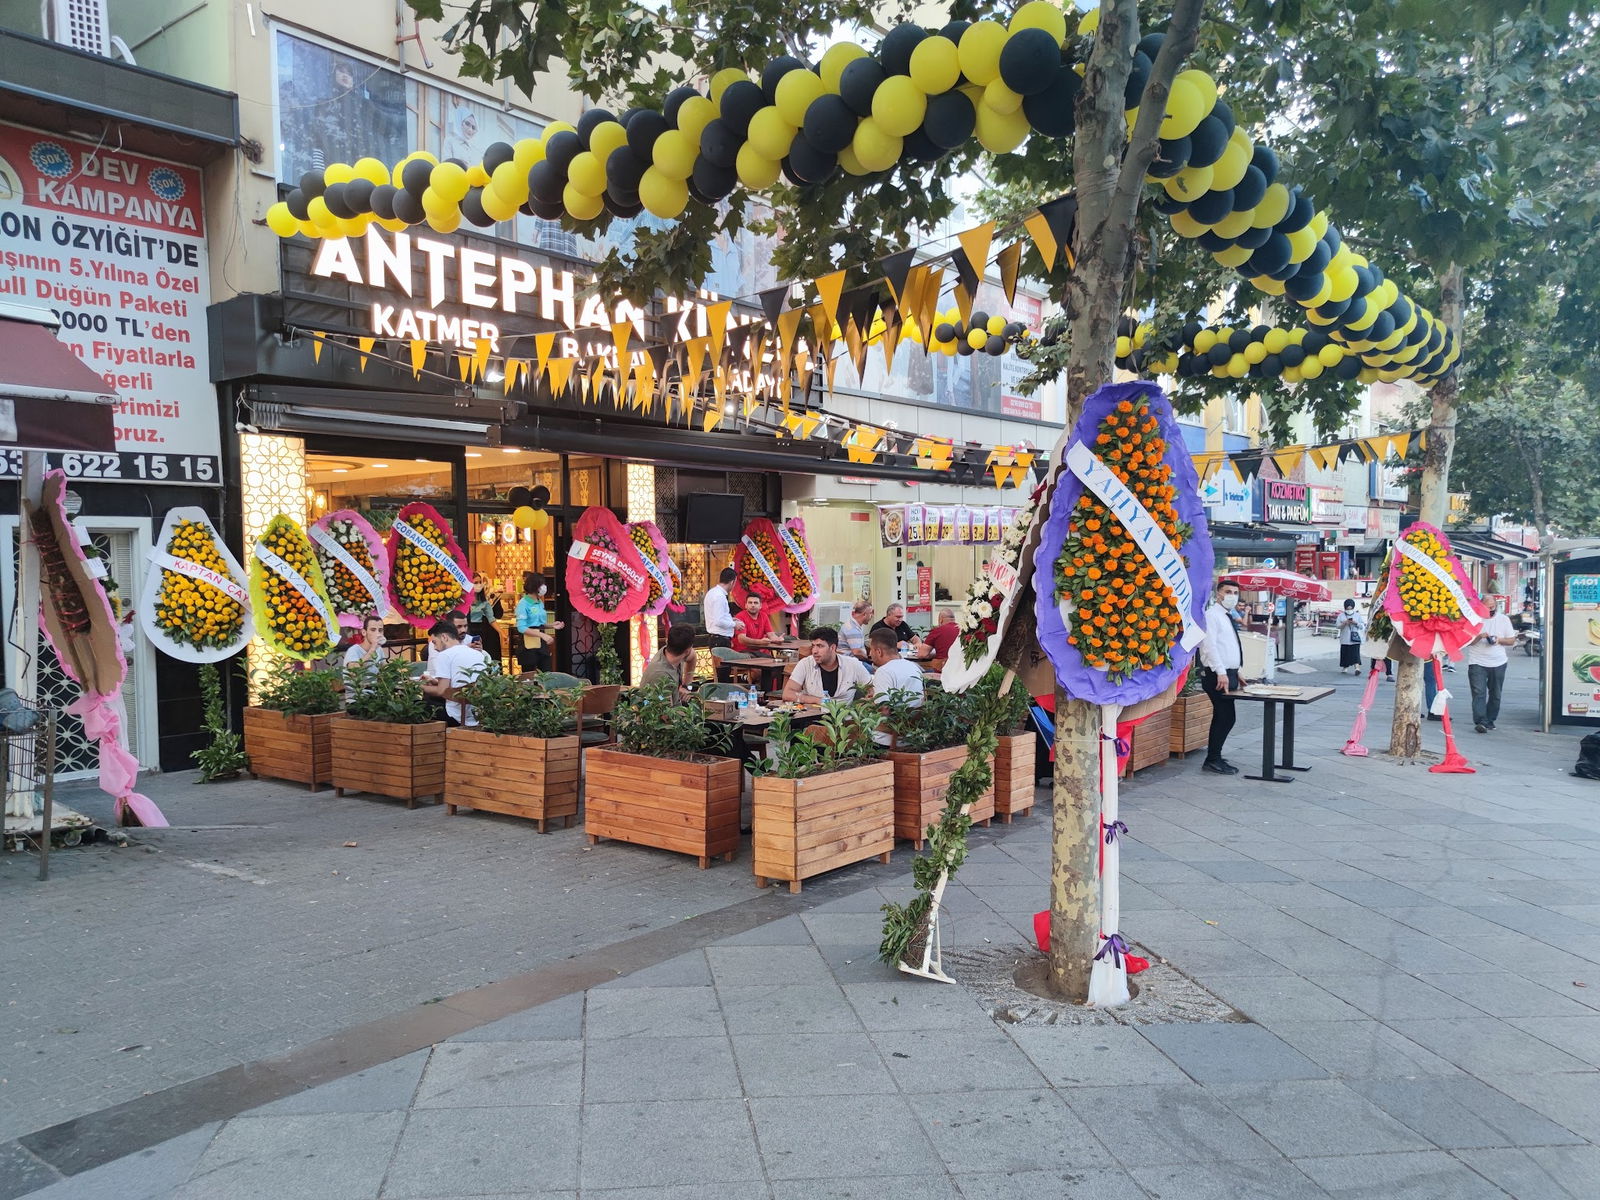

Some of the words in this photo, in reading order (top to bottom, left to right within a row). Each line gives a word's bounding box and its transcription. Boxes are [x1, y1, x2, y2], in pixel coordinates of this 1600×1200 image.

[81, 152, 139, 185] DEV
[38, 178, 197, 231] KAMPANYA
[0, 211, 42, 242] ON
[52, 215, 199, 268] ÖZYİĞİT'DE
[69, 257, 148, 286] 5.Yılına
[155, 267, 199, 294] Özel
[36, 279, 111, 308] Düğün
[119, 290, 187, 318] Paketi
[373, 303, 500, 353] KATMER
[92, 341, 196, 370] Fiyatlarla
[62, 453, 122, 478] 622
[133, 455, 169, 480] 15
[180, 456, 214, 481] 15
[1083, 457, 1155, 543] YAHYA
[174, 560, 223, 585] KAPTAN
